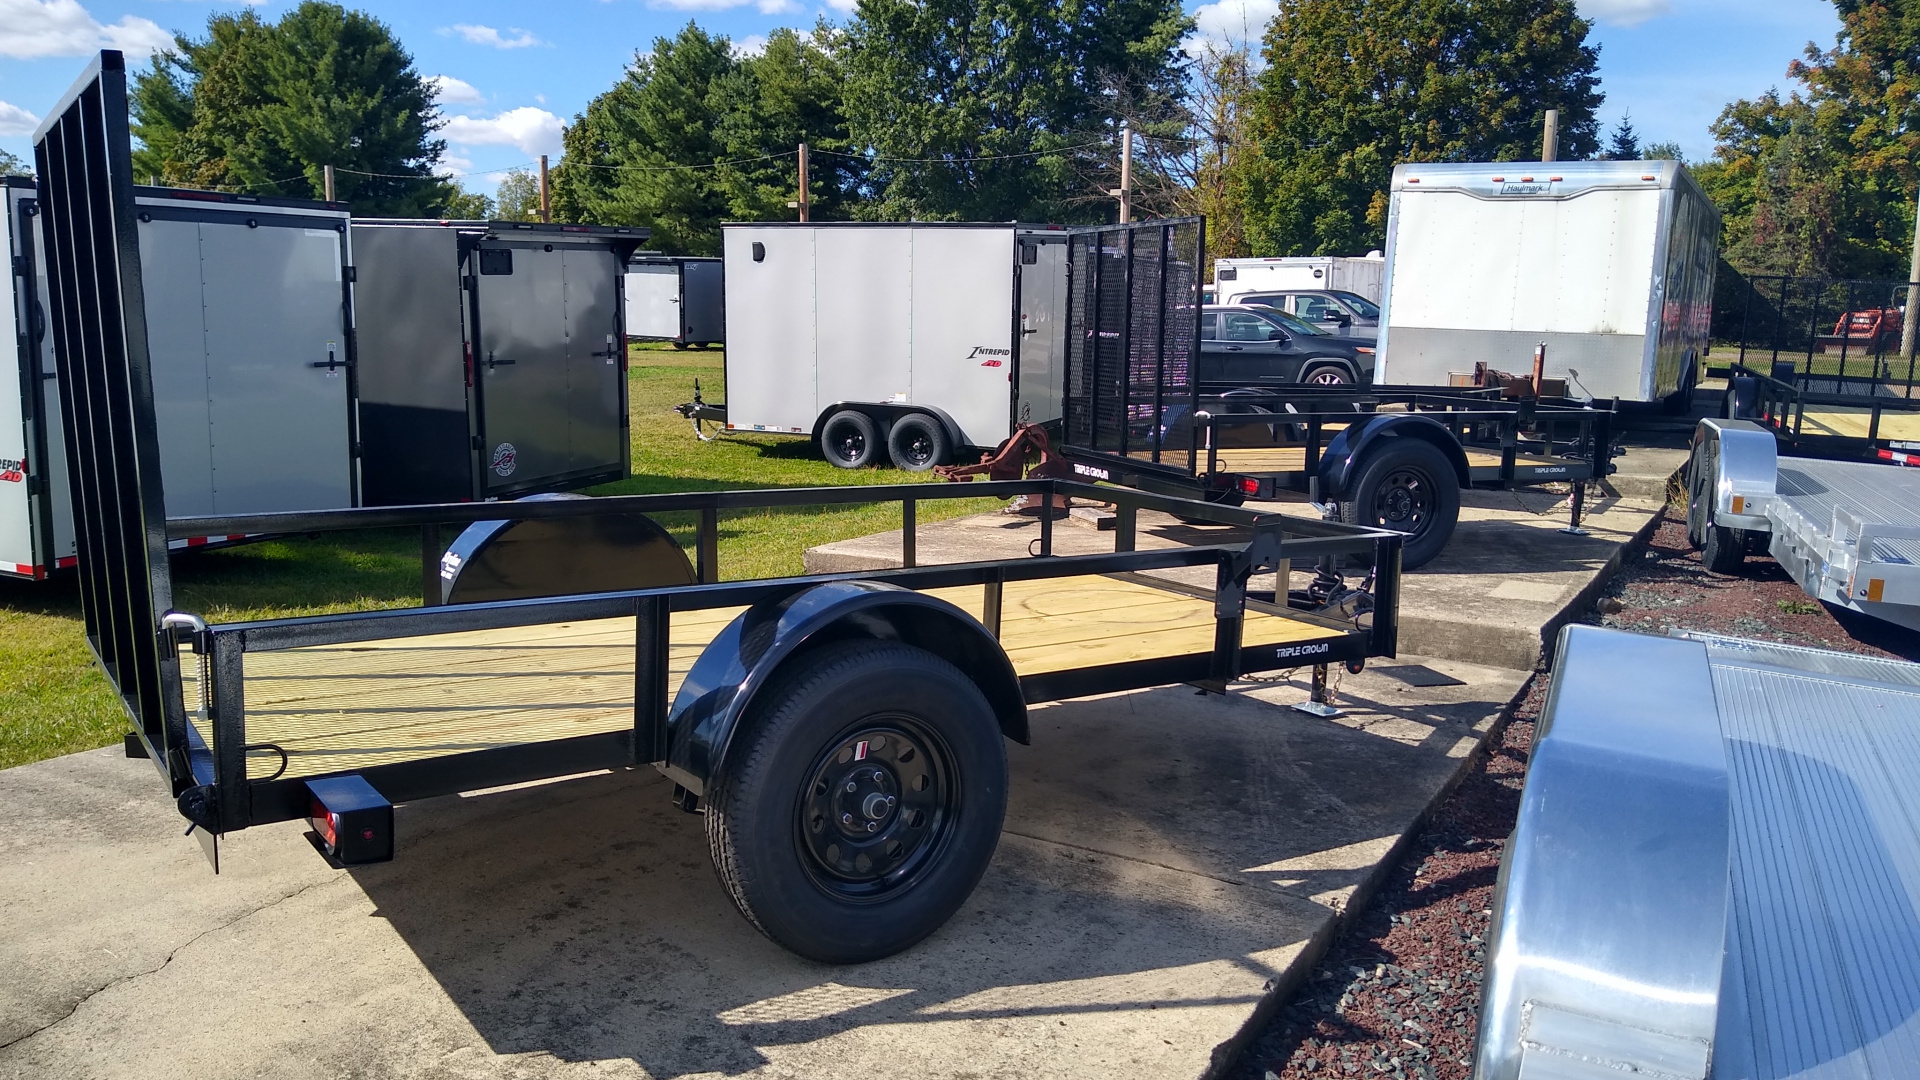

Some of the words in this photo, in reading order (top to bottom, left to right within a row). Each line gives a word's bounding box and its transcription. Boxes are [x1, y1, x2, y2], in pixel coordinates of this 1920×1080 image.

[1506, 184, 1543, 192] Haulmark
[966, 346, 1010, 360] INTREPID
[1074, 463, 1090, 476] TRIPLE
[1090, 467, 1109, 480] CROWN
[1276, 646, 1301, 659] TRIPLE
[1301, 643, 1329, 655] CROWN
